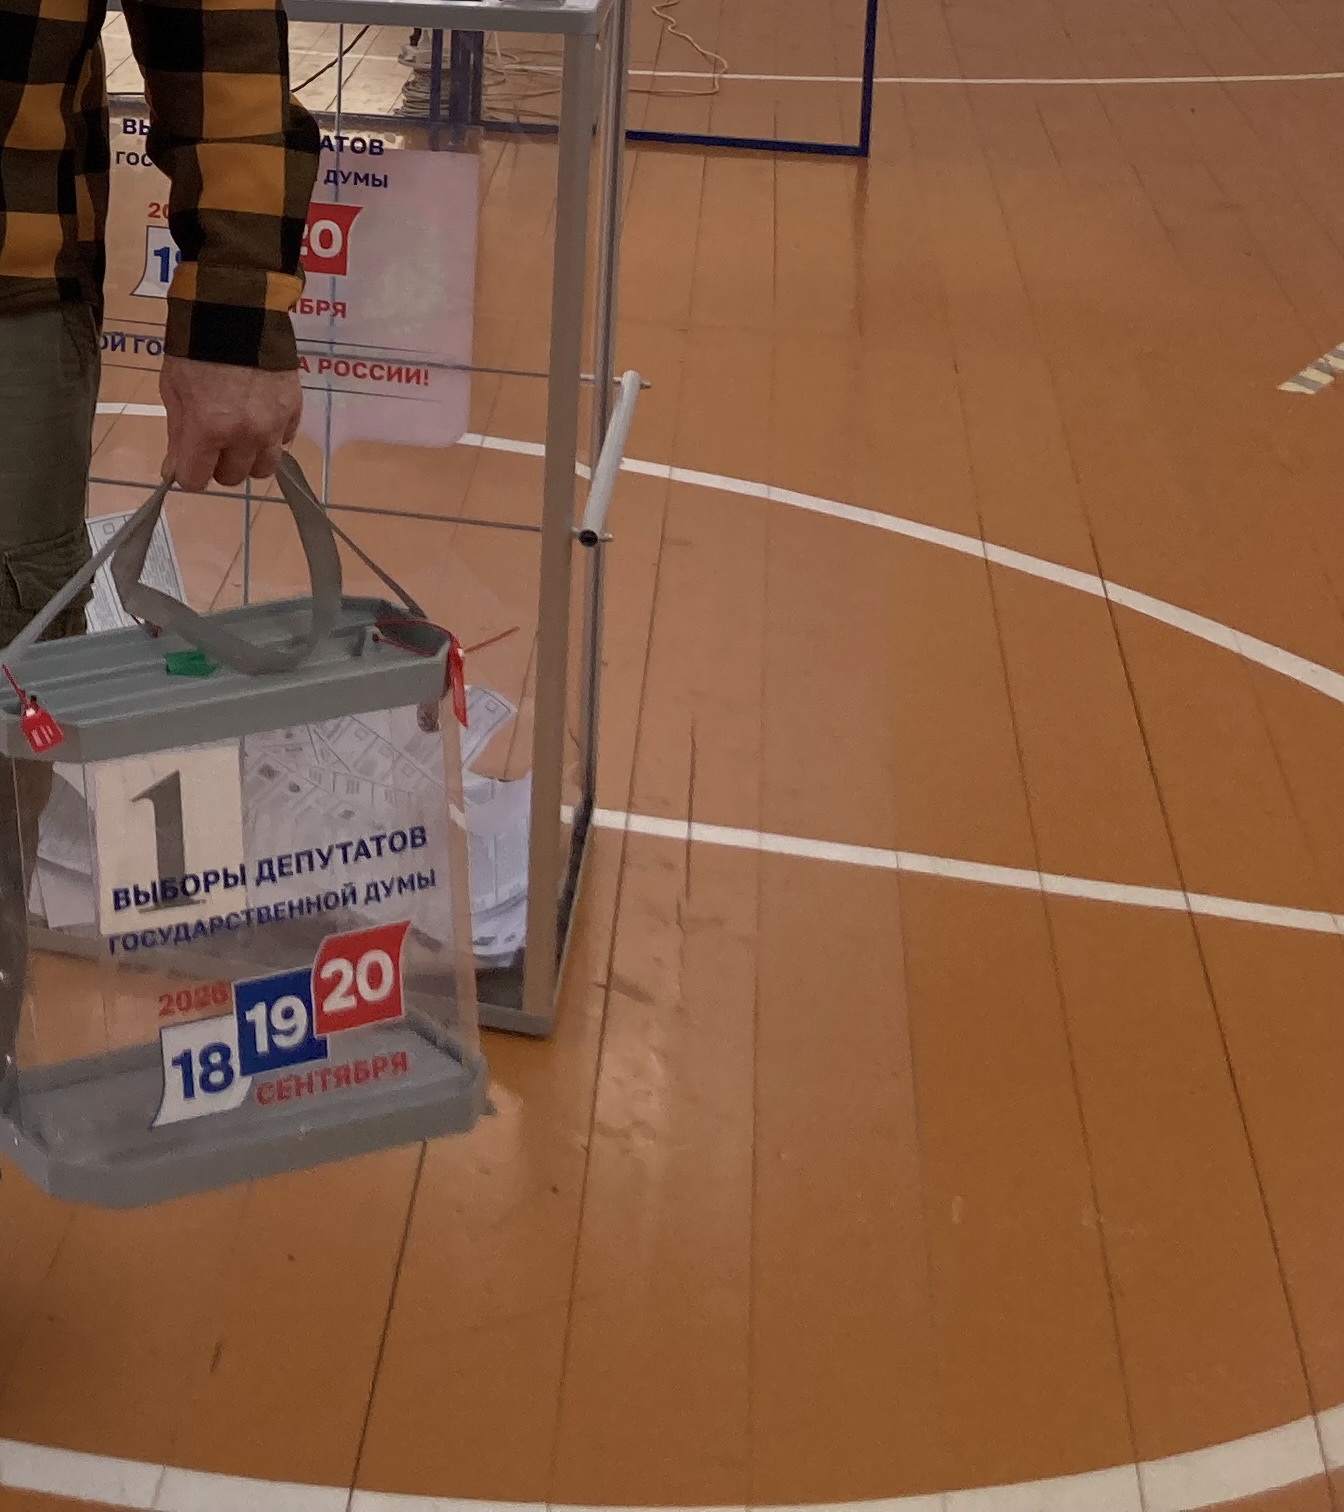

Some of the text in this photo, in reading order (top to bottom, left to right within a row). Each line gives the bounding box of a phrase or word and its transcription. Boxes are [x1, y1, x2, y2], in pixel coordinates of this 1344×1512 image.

[324, 169, 388, 189] ДУМЫ
[300, 219, 343, 258] 0
[318, 357, 429, 387] РОССИИ!
[112, 825, 428, 913] ВЫБОРЫ ДЕПУТАТОВ
[130, 769, 207, 915] 1
[109, 868, 437, 955] ГОСУДАРСТВЕННОЙ ДУМЫ
[157, 980, 230, 1017] 2026
[320, 949, 394, 1013] 20
[245, 996, 309, 1056] 19
[171, 1042, 235, 1101] 18
[256, 1050, 408, 1107] СЕНТЯБРЯ
